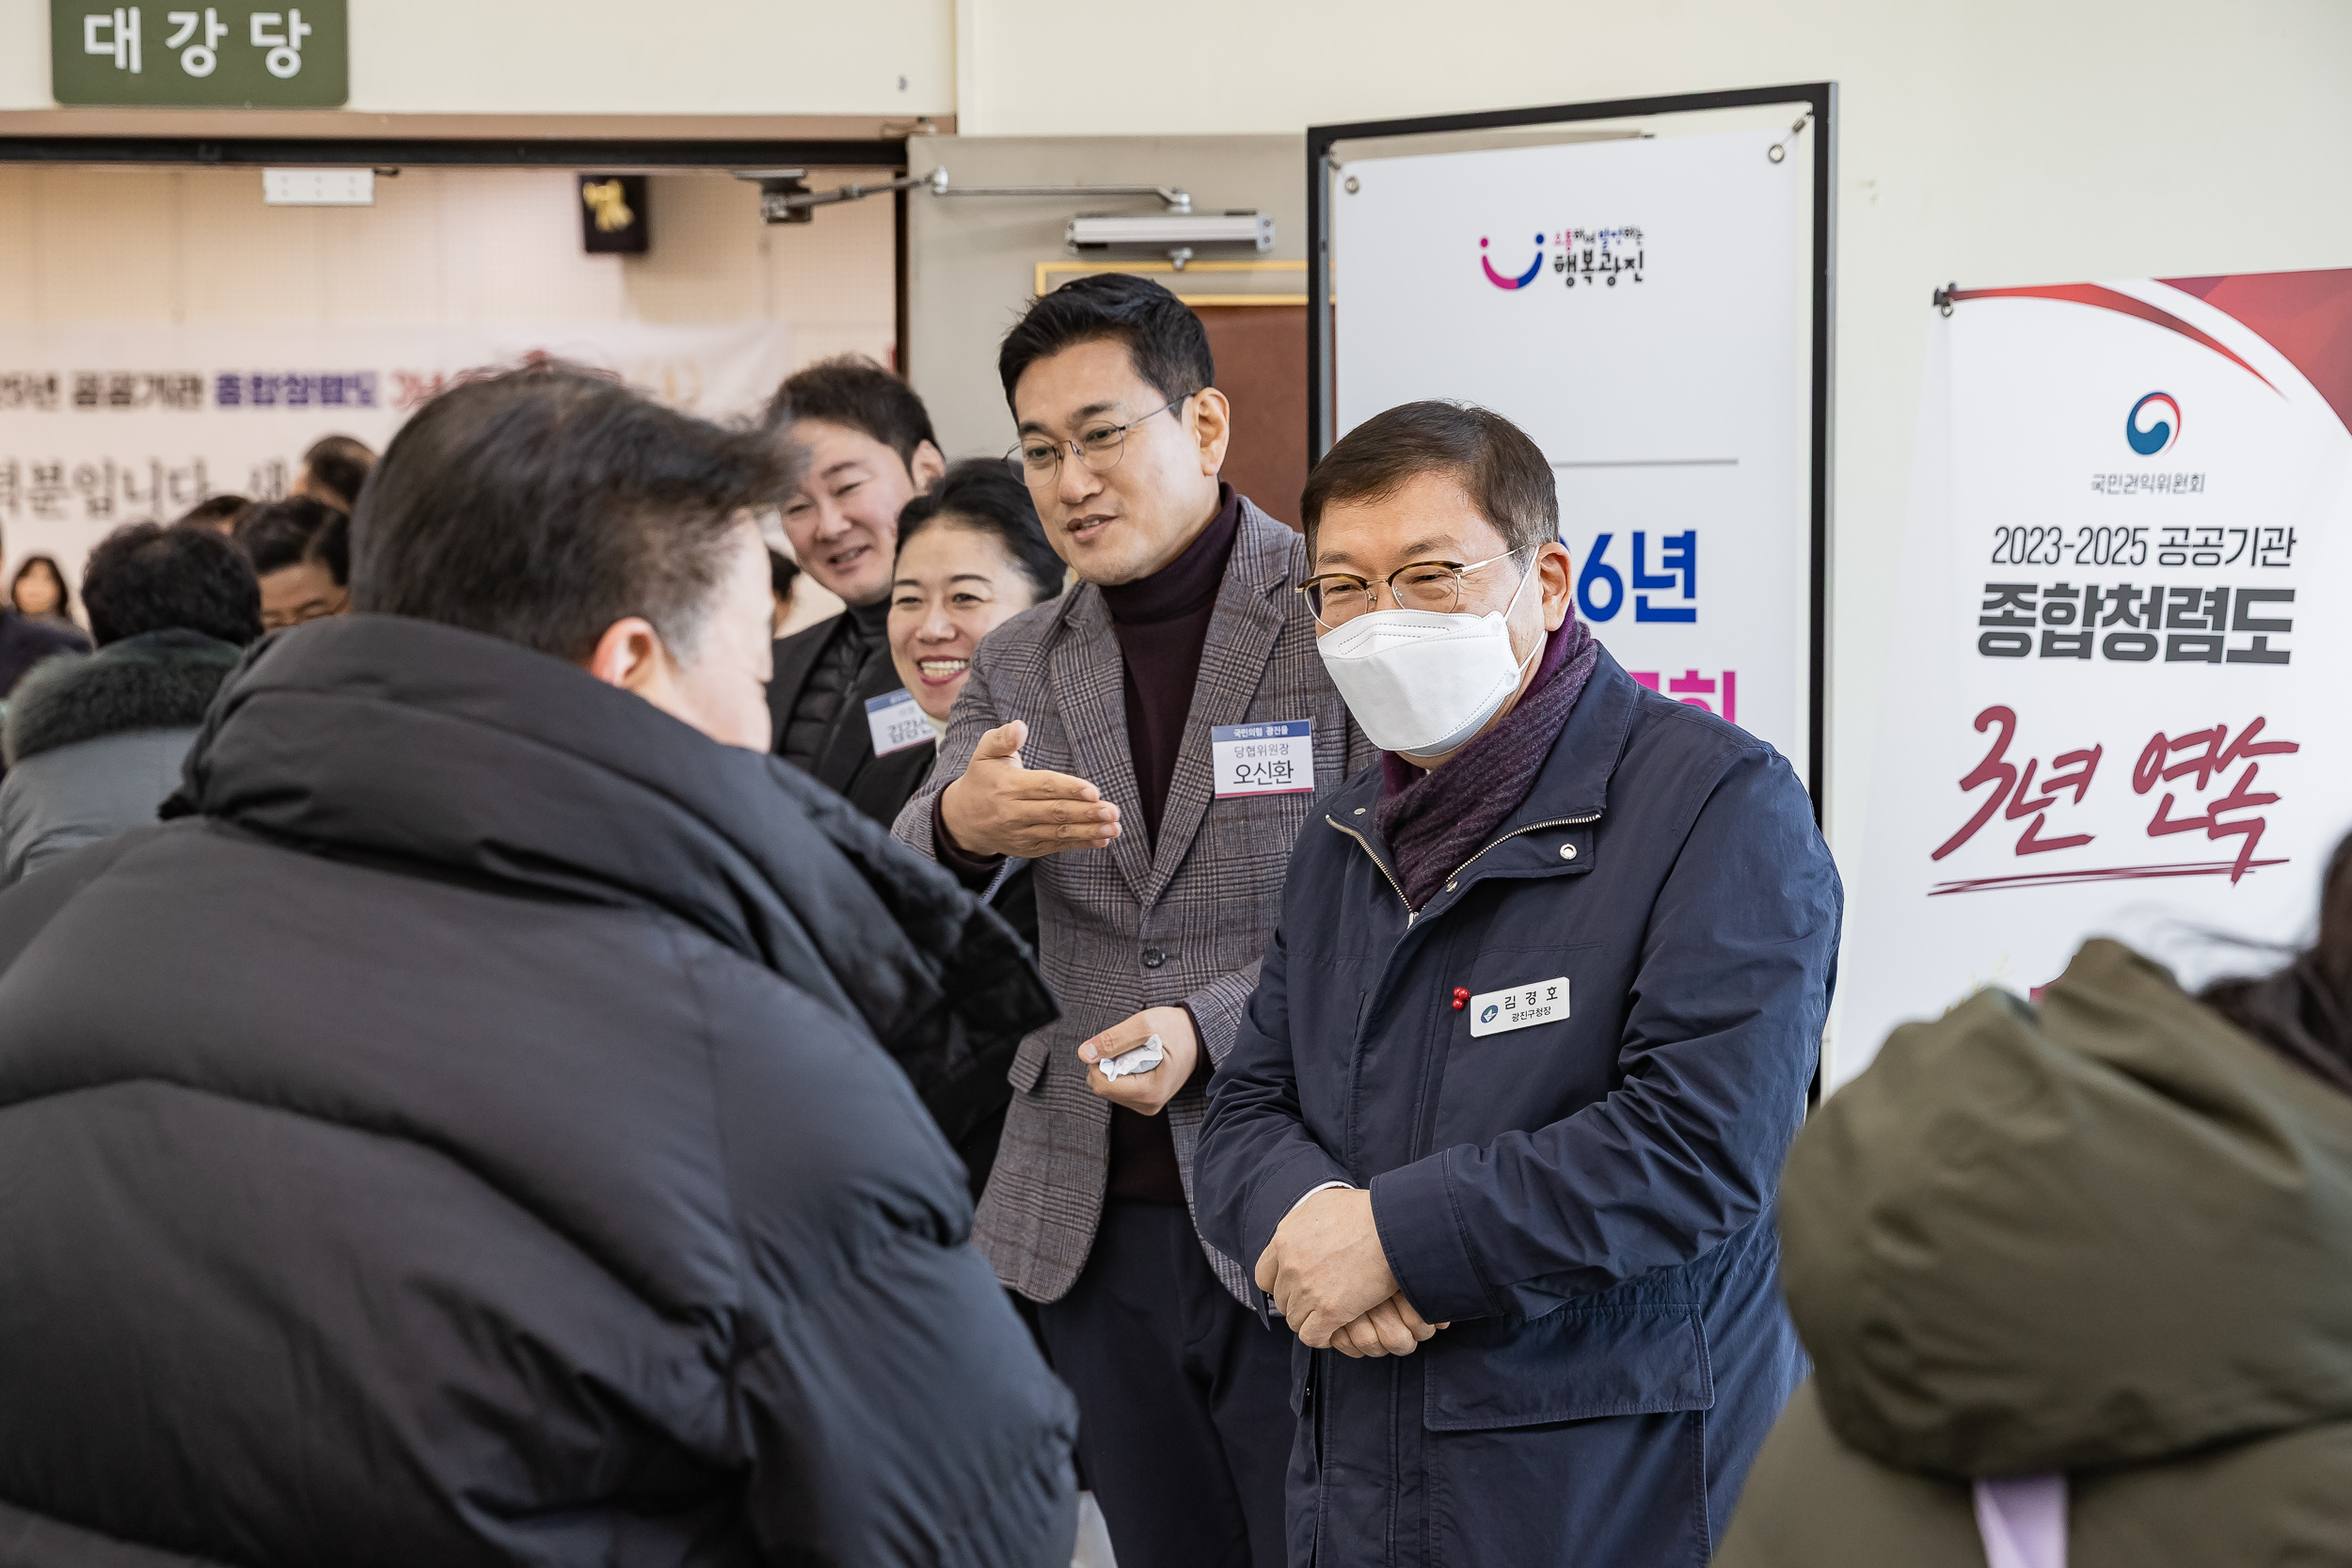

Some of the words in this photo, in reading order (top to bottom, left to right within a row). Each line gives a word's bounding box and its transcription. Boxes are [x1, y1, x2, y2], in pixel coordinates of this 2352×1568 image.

[1553, 248, 1644, 287] 행복광진
[2090, 472, 2206, 496] 국민권익위원회
[1990, 525, 2151, 566] 2023-2025
[2157, 525, 2297, 568] 공공기관
[1559, 529, 1697, 624] 6년
[1976, 580, 2296, 666] 종합청렴도
[1233, 742, 1290, 759] 당협위원장
[1232, 759, 1295, 785] 오신환
[1930, 705, 2104, 863] 3년
[2131, 715, 2300, 886] 연속
[1503, 986, 1558, 1011] 김경호
[1511, 1006, 1551, 1023] 광진구청장
